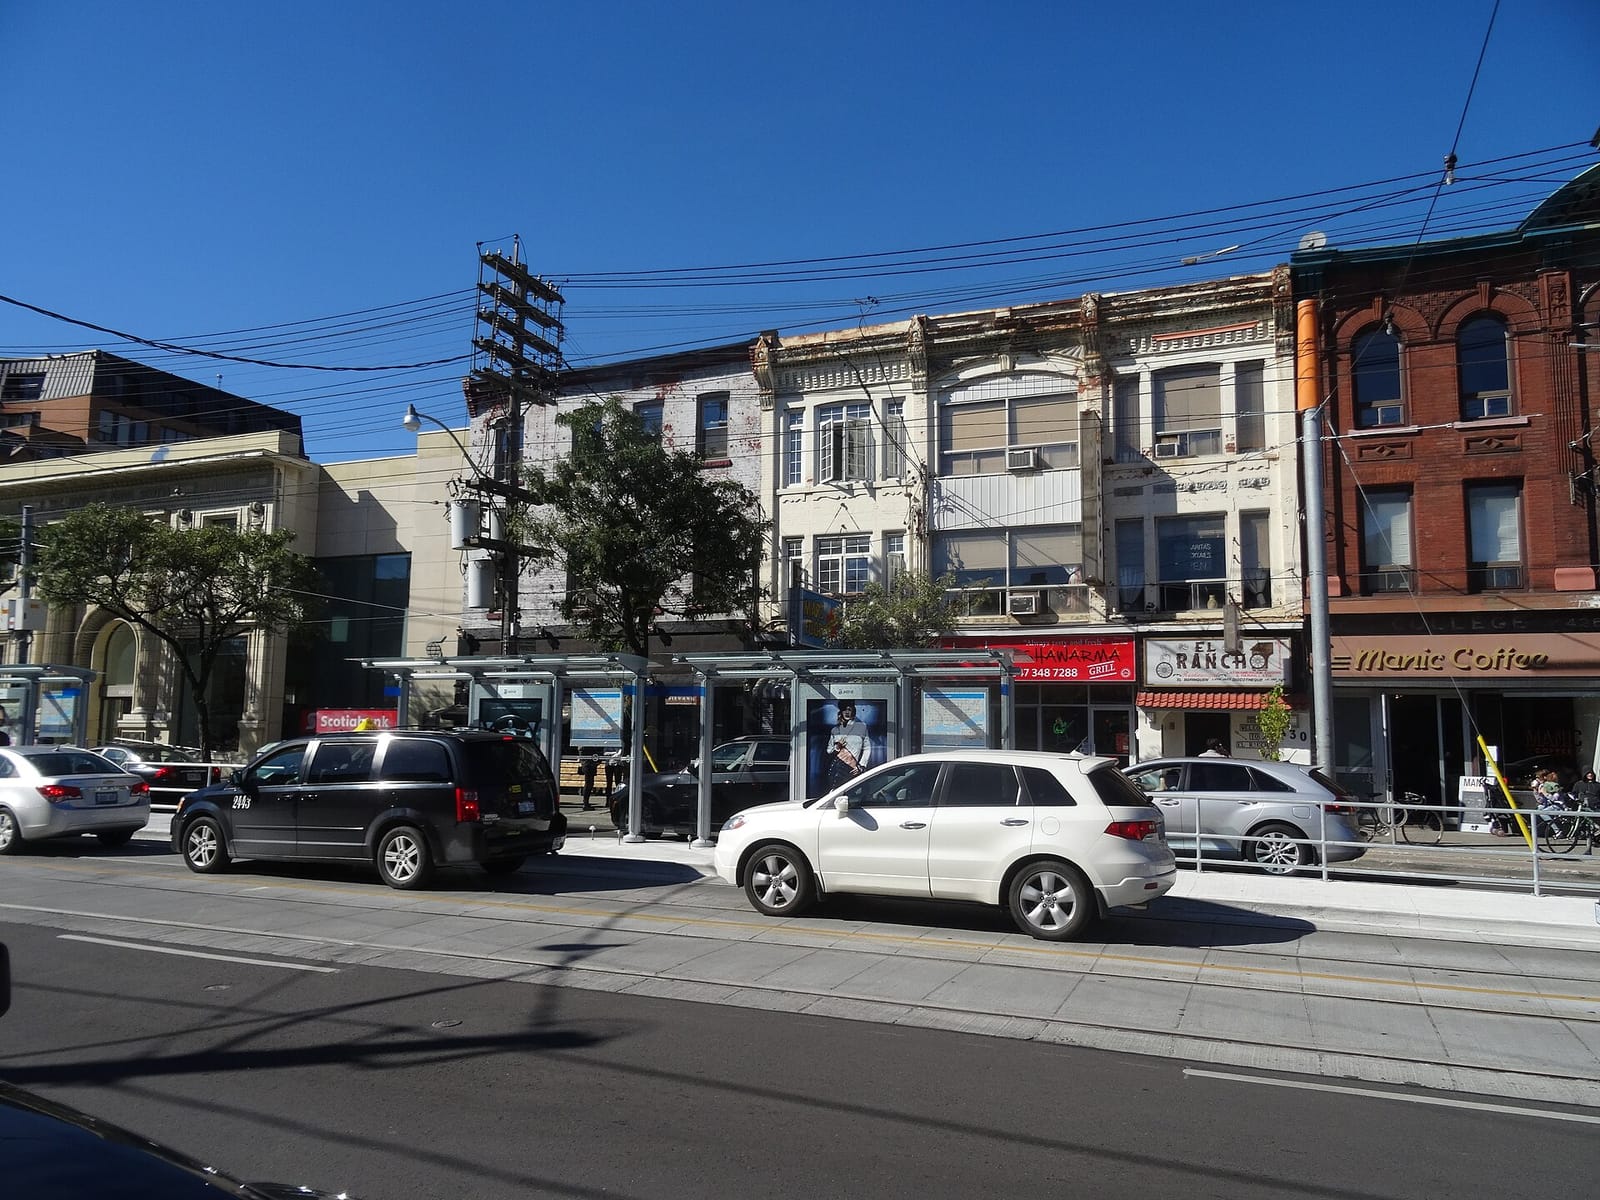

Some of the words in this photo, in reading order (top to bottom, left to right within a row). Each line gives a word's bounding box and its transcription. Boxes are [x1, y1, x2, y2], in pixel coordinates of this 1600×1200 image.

[1391, 617, 1528, 631] COLLEGE
[1194, 641, 1217, 653] EL
[1355, 648, 1446, 671] Manic
[1449, 647, 1549, 671] Coffee
[1031, 668, 1051, 678] 348
[1053, 668, 1078, 678] 7288
[1088, 663, 1116, 676] GRILL
[320, 715, 389, 727] Scotiabnk
[232, 795, 251, 809] 2443
